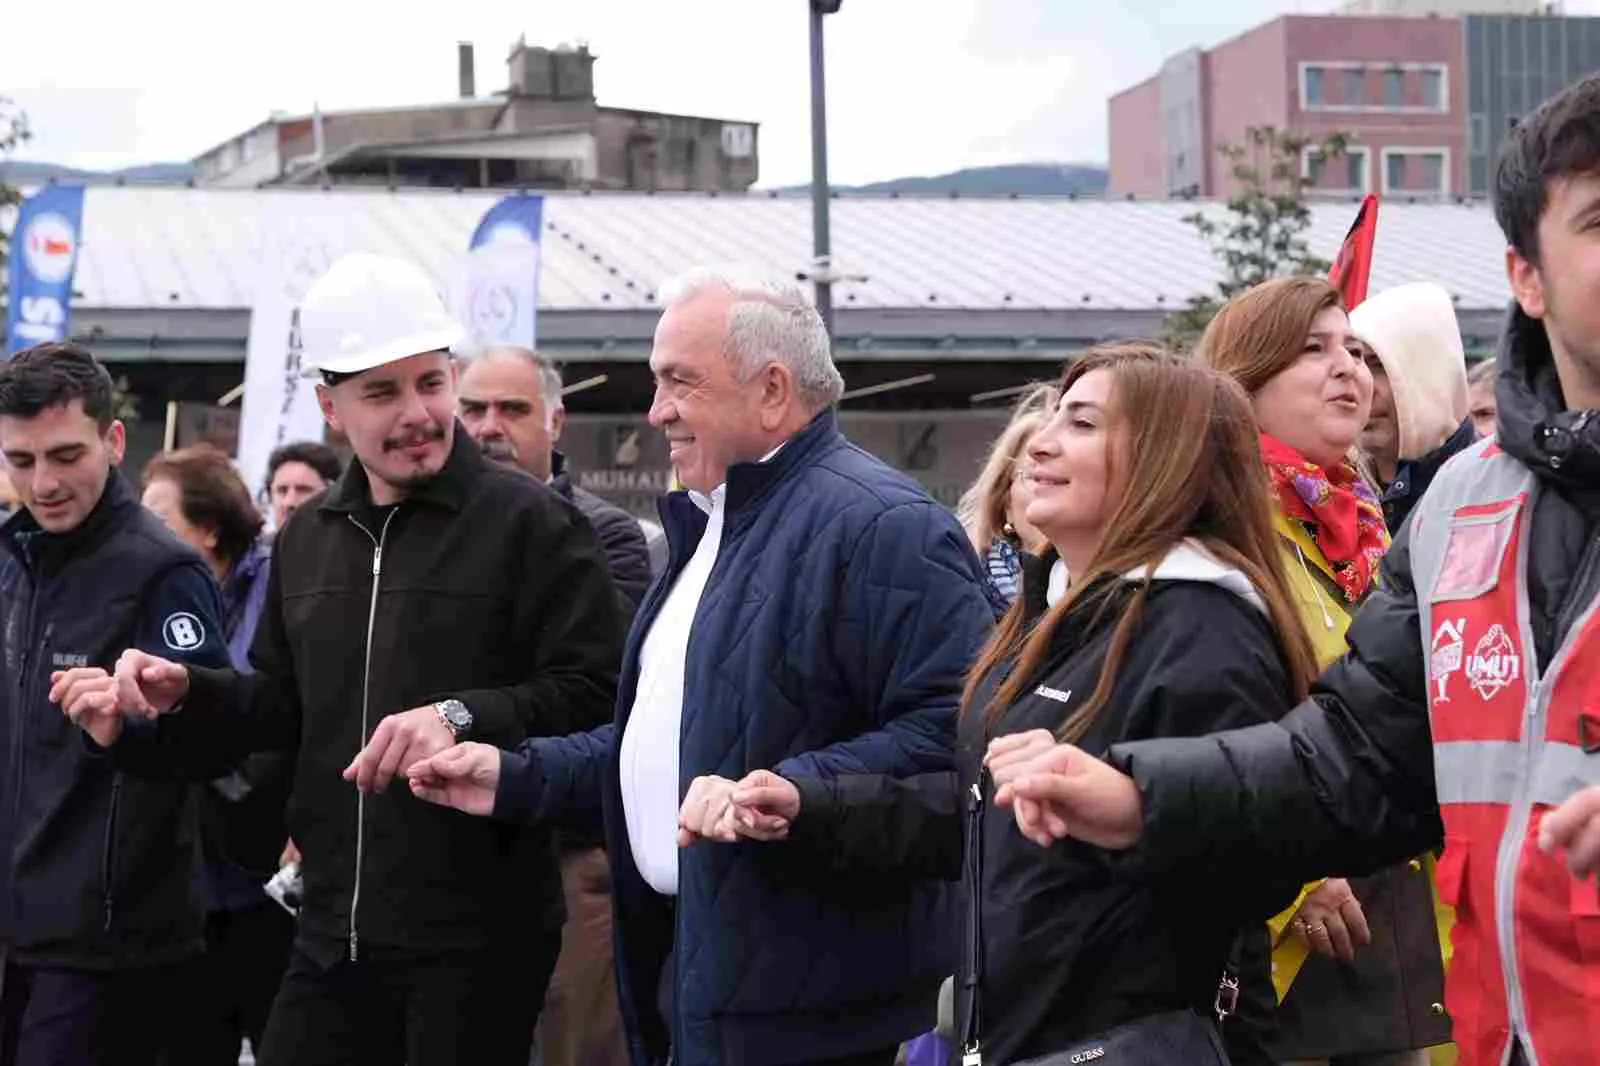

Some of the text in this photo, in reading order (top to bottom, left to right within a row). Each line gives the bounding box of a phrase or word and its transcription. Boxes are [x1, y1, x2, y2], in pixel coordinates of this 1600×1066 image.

[580, 470, 669, 490] MUHAL
[169, 616, 198, 647] B
[1071, 1047, 1105, 1064] GUESS
